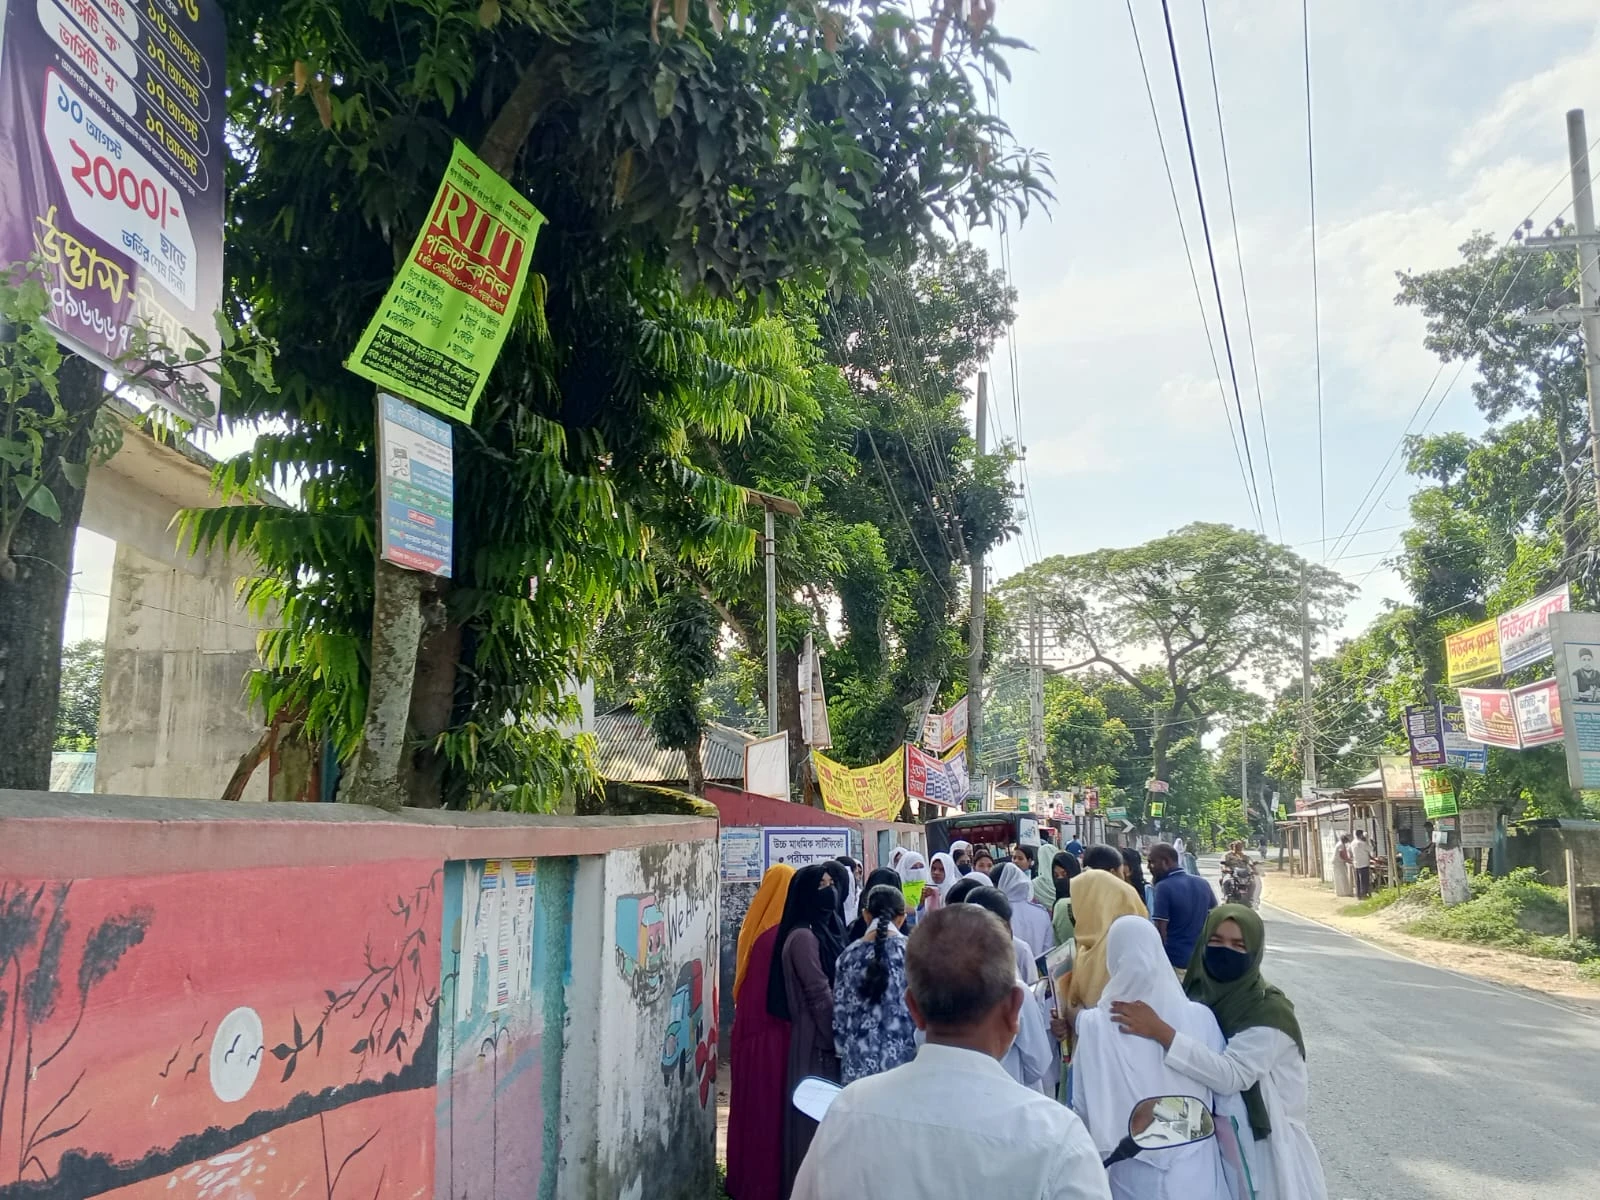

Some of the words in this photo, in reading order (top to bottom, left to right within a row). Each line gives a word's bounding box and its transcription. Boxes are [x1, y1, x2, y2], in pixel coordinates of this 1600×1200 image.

[59, 22, 100, 76] ভার্সিটি
[147, 36, 166, 73] ১৭
[167, 60, 199, 107] আগস্ট
[169, 25, 200, 73] আগস্ট
[57, 84, 83, 124] ১০
[85, 117, 123, 160] আগস্ট
[146, 72, 165, 108] ১৭
[166, 96, 199, 142] আগস্ট
[145, 109, 164, 144] ১৭
[165, 132, 198, 176] আগস্ট
[69, 138, 180, 230] ২০০০/-
[426, 234, 511, 298] পলিটেকনিক
[773, 838, 787, 849] উচ্চ
